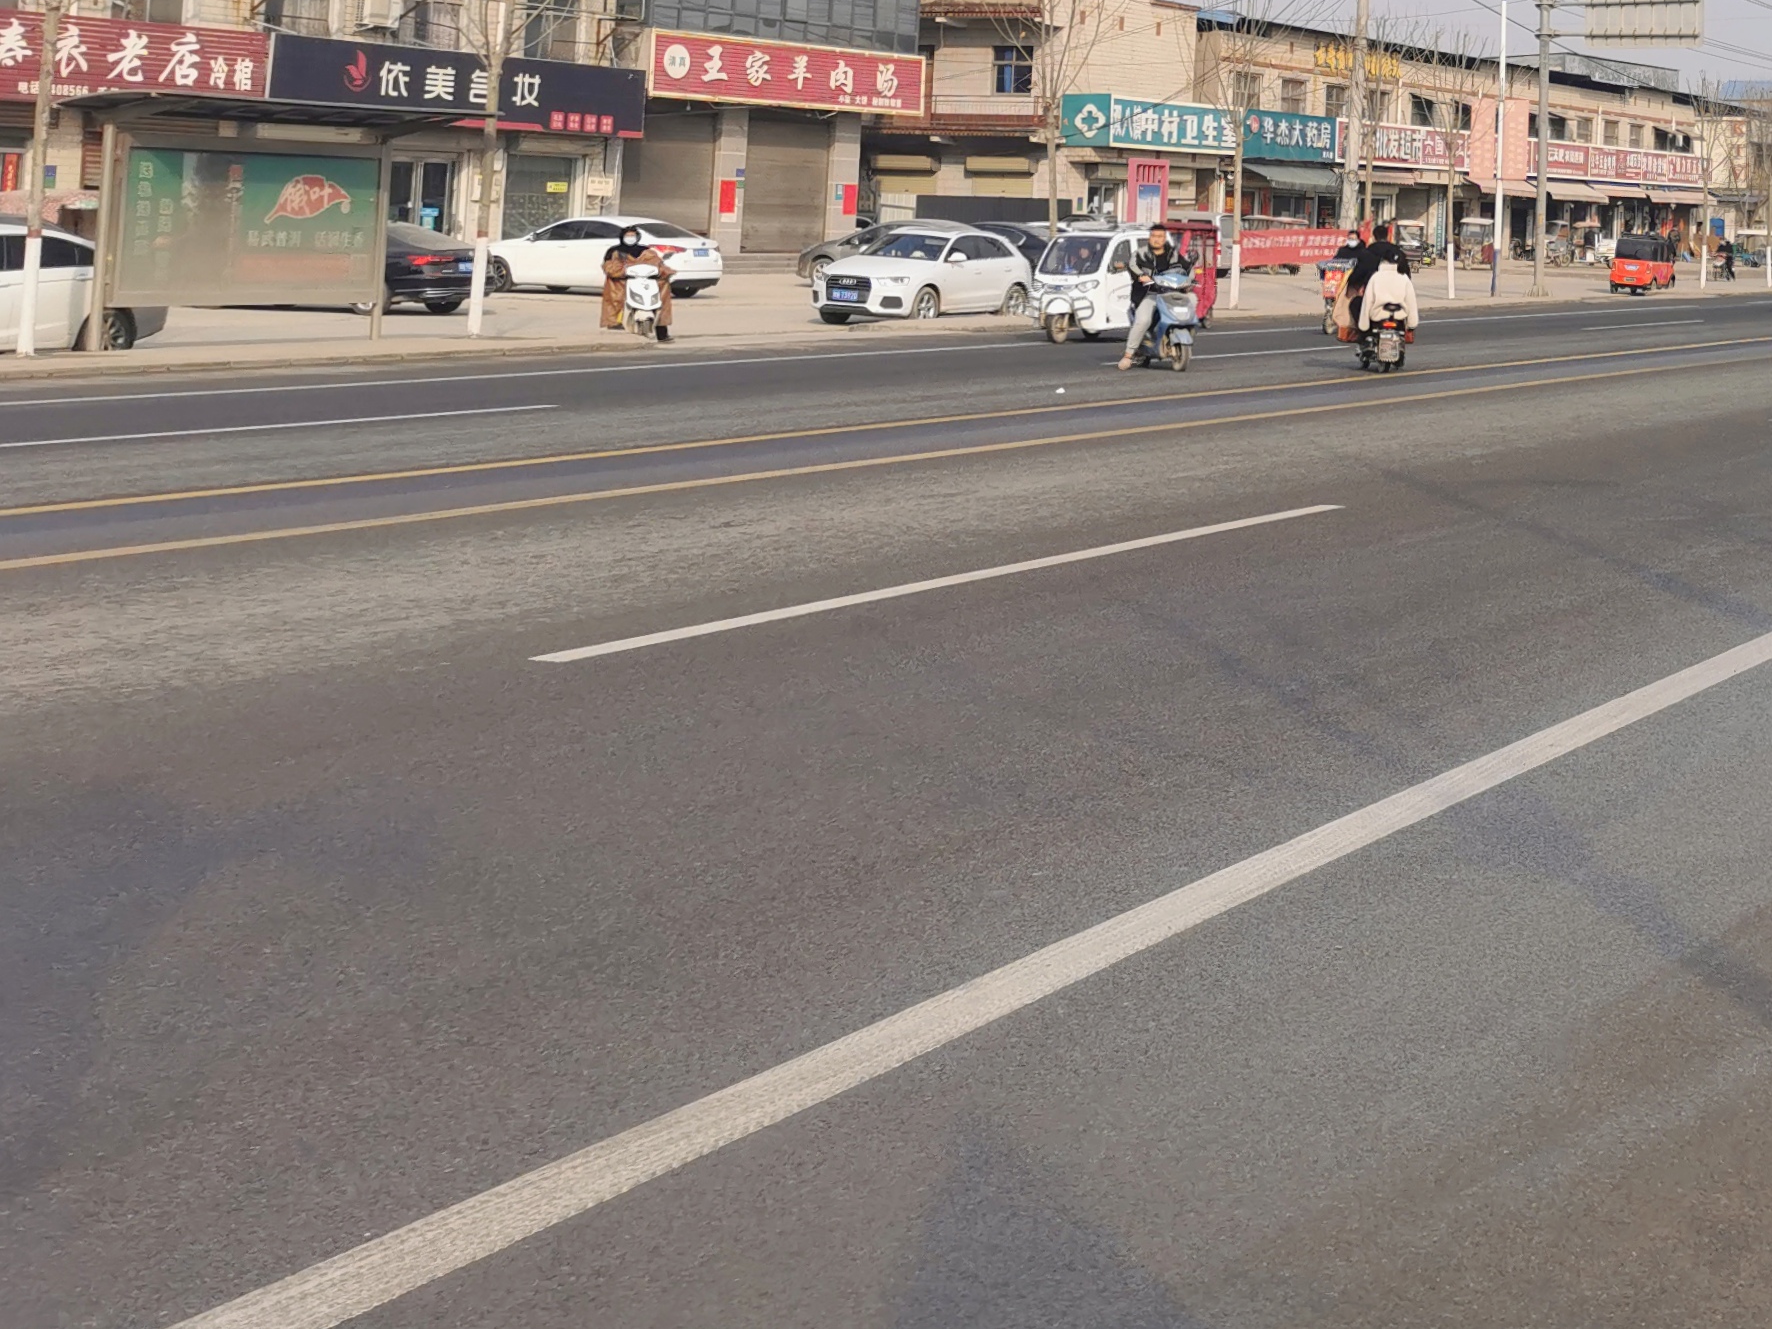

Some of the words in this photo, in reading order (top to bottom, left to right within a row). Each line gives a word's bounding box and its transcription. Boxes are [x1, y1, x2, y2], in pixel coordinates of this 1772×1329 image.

[701, 45, 900, 97] 王家羊肉汤
[1261, 117, 1331, 149] 华杰大药房
